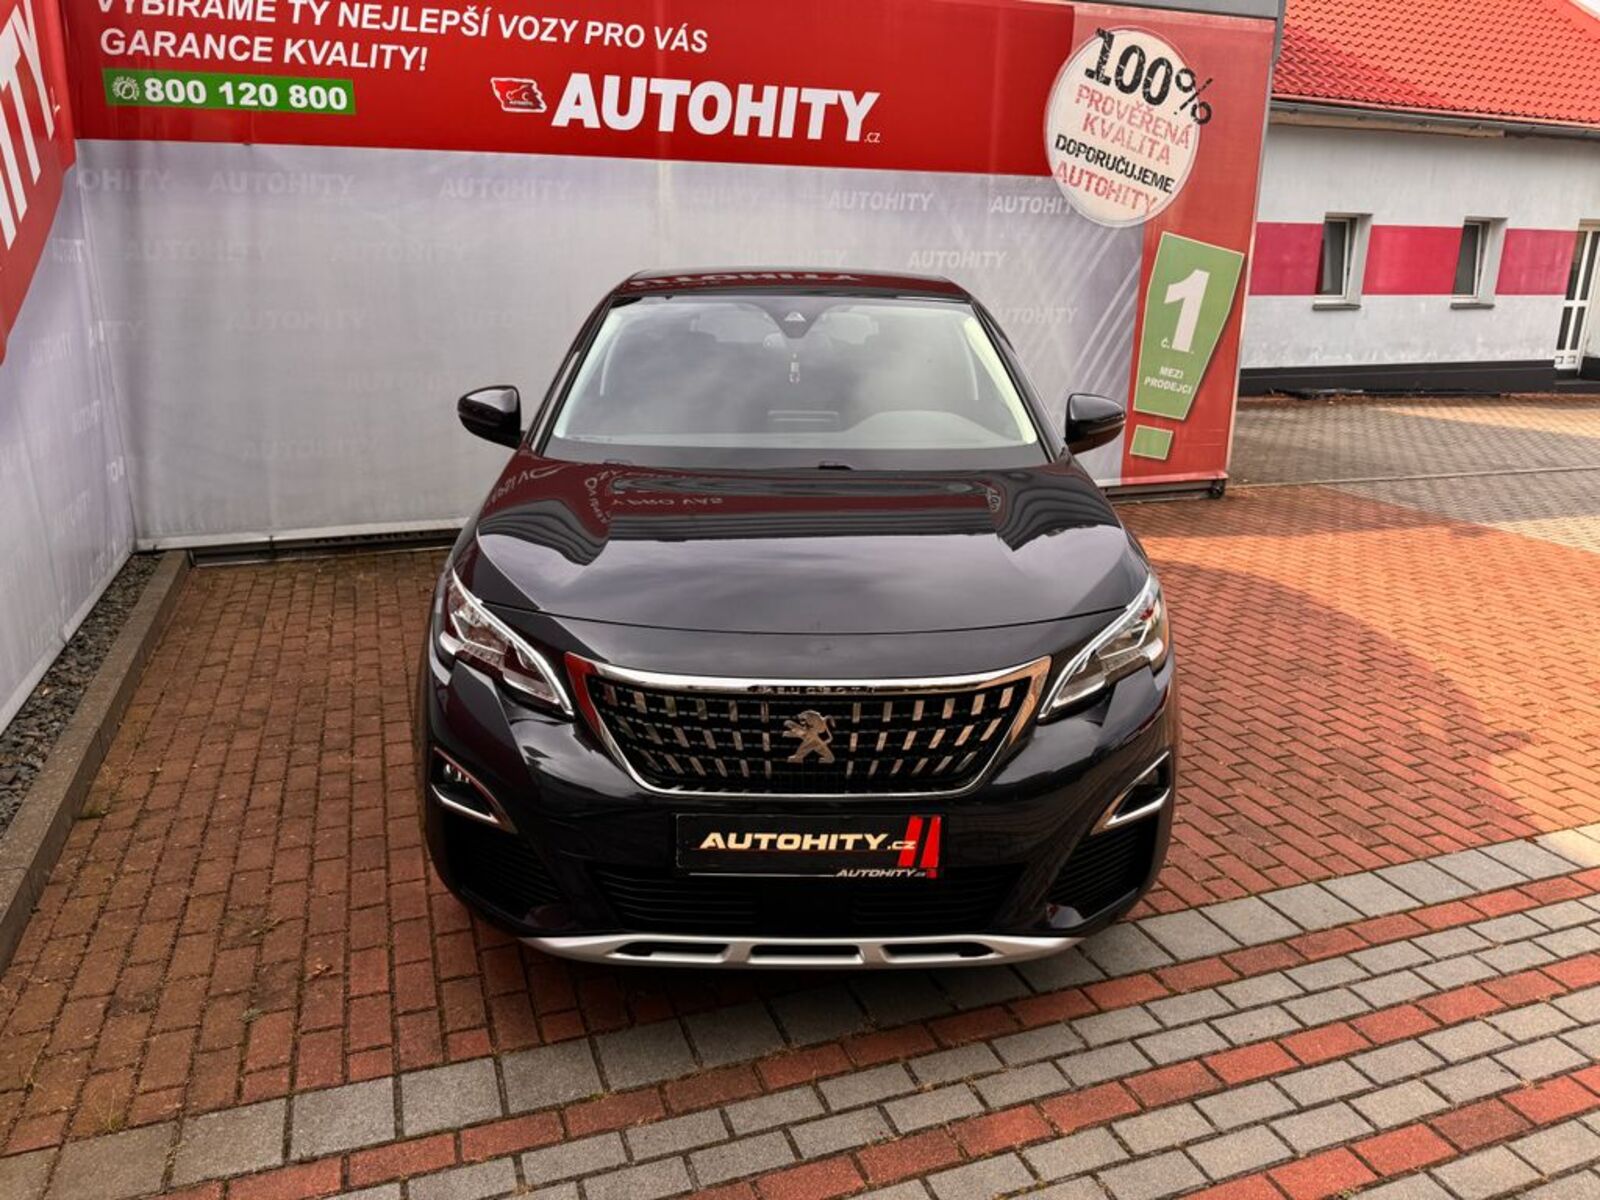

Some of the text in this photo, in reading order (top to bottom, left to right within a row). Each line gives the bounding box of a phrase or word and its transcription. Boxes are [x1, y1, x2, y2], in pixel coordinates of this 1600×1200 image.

[100, 27, 428, 71] GARANCE KVALITY!
[290, 0, 330, 25] TY
[338, 2, 492, 37] NEJLEPŠÍ
[499, 14, 578, 43] VOZY
[584, 21, 645, 48] PRO
[654, 24, 708, 53] VÁS
[144, 78, 347, 110] 800 120 800
[1085, 28, 1213, 125] 100%
[1074, 84, 1193, 149] PROVĚŘENÁ
[1082, 113, 1170, 166] KVALITA
[1055, 133, 1175, 194] DOPORUČUJEME
[1057, 160, 1158, 214] AUTOHITY
[827, 189, 934, 212] AUTOHITY
[907, 249, 1007, 271] AUTOHITY
[1144, 376, 1193, 395] PRODEJCI
[1160, 365, 1184, 378] MEZI
